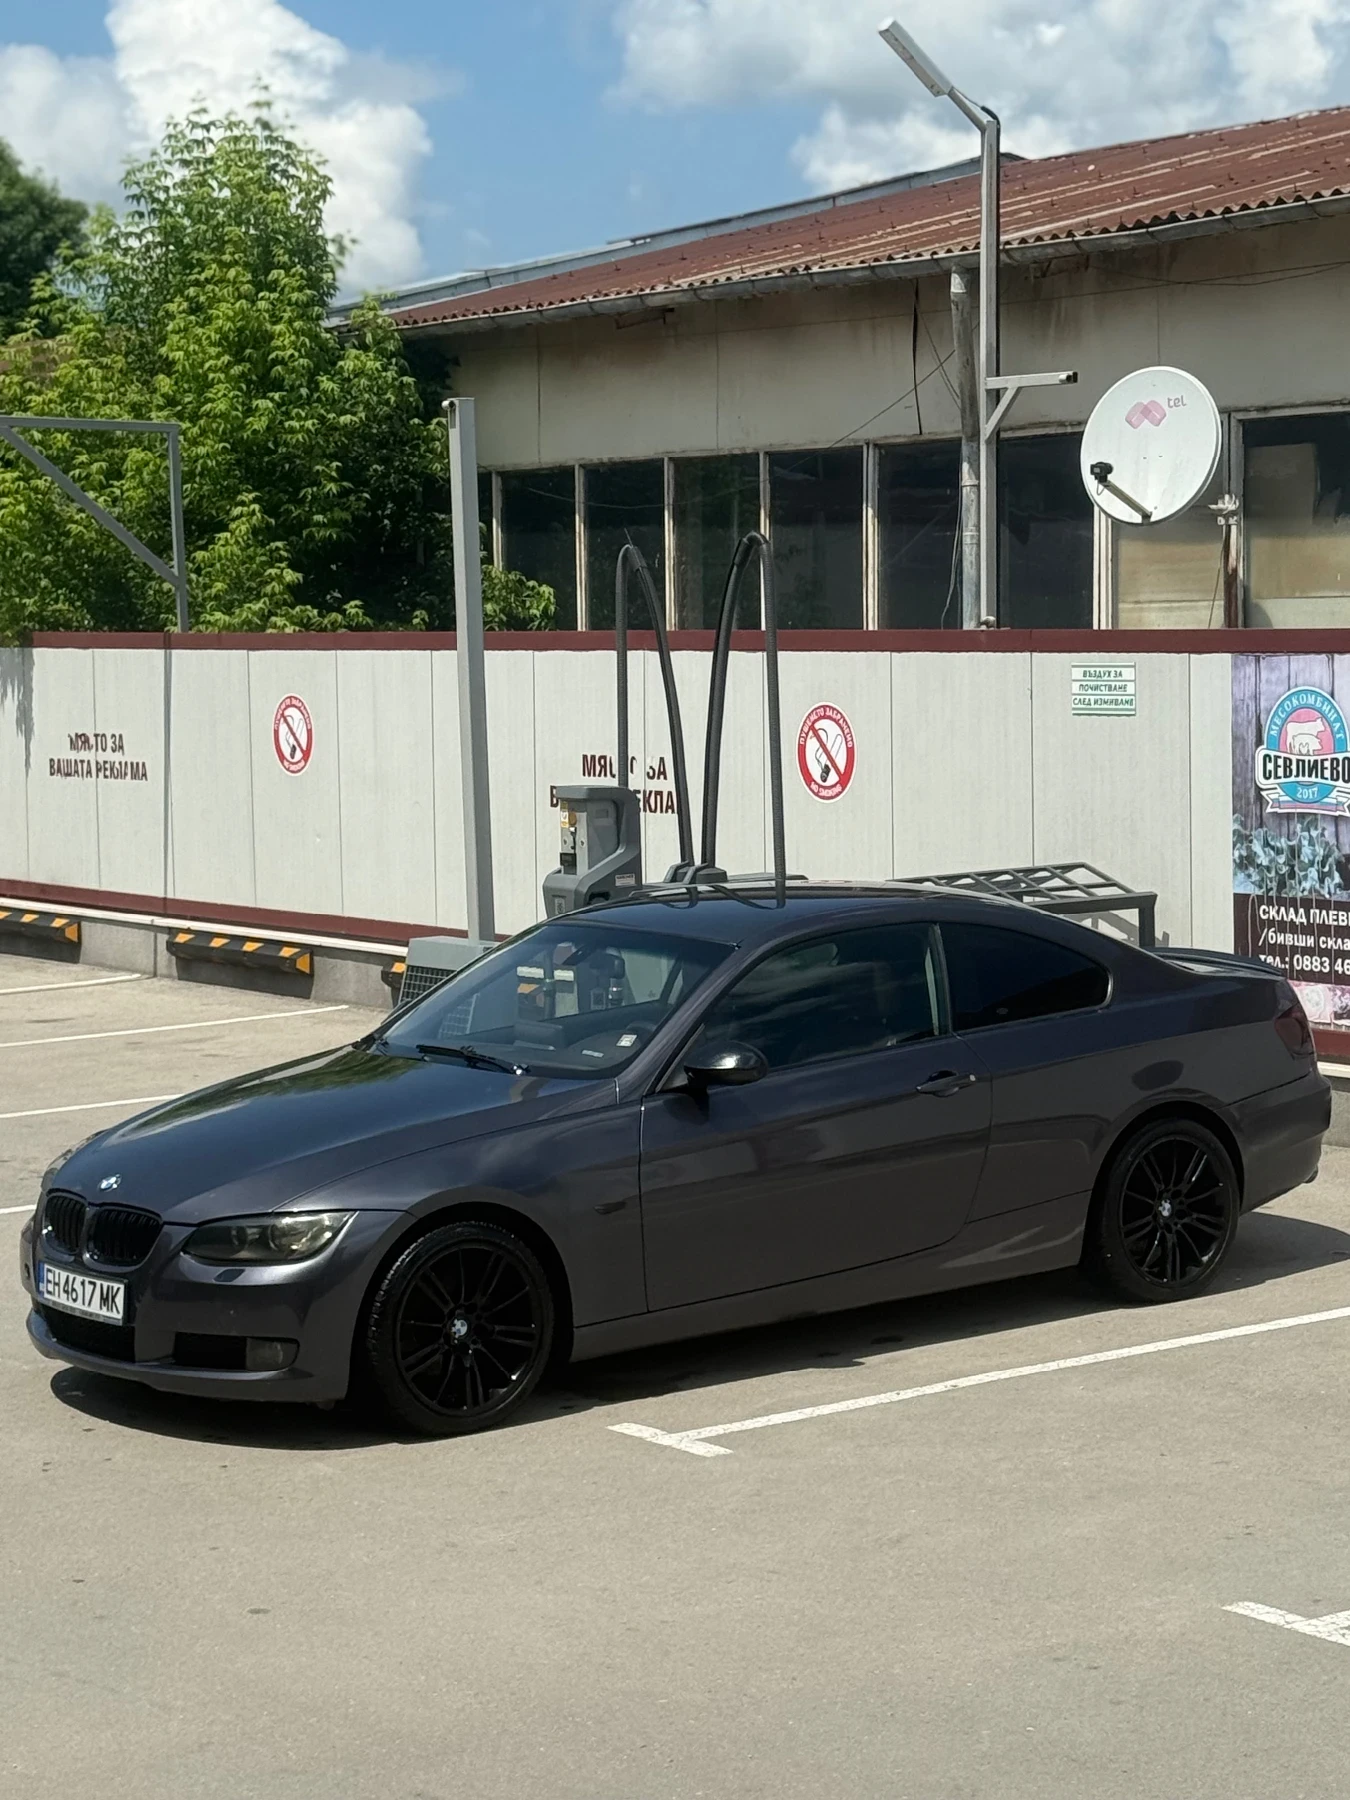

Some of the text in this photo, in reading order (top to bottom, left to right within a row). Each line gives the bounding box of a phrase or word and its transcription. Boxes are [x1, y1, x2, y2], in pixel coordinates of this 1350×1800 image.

[1167, 395, 1187, 408] tel
[1082, 670, 1123, 679] ВЪЗДУХ ЗА
[1079, 684, 1127, 692] ПОЧИСТВАНЕ
[1072, 698, 1092, 706] СЛЕД
[1270, 694, 1344, 740] МЕСОКОМБИНАТ
[110, 733, 125, 756] ЗА
[49, 758, 93, 779] ВАШАТА
[1262, 754, 1350, 783] СЕВЛИЕВО
[1297, 787, 1318, 799] 2017
[1260, 905, 1350, 926] СКЛАД ПЛЕВ
[1258, 927, 1314, 948] /бивши
[1293, 954, 1330, 973] 0883
